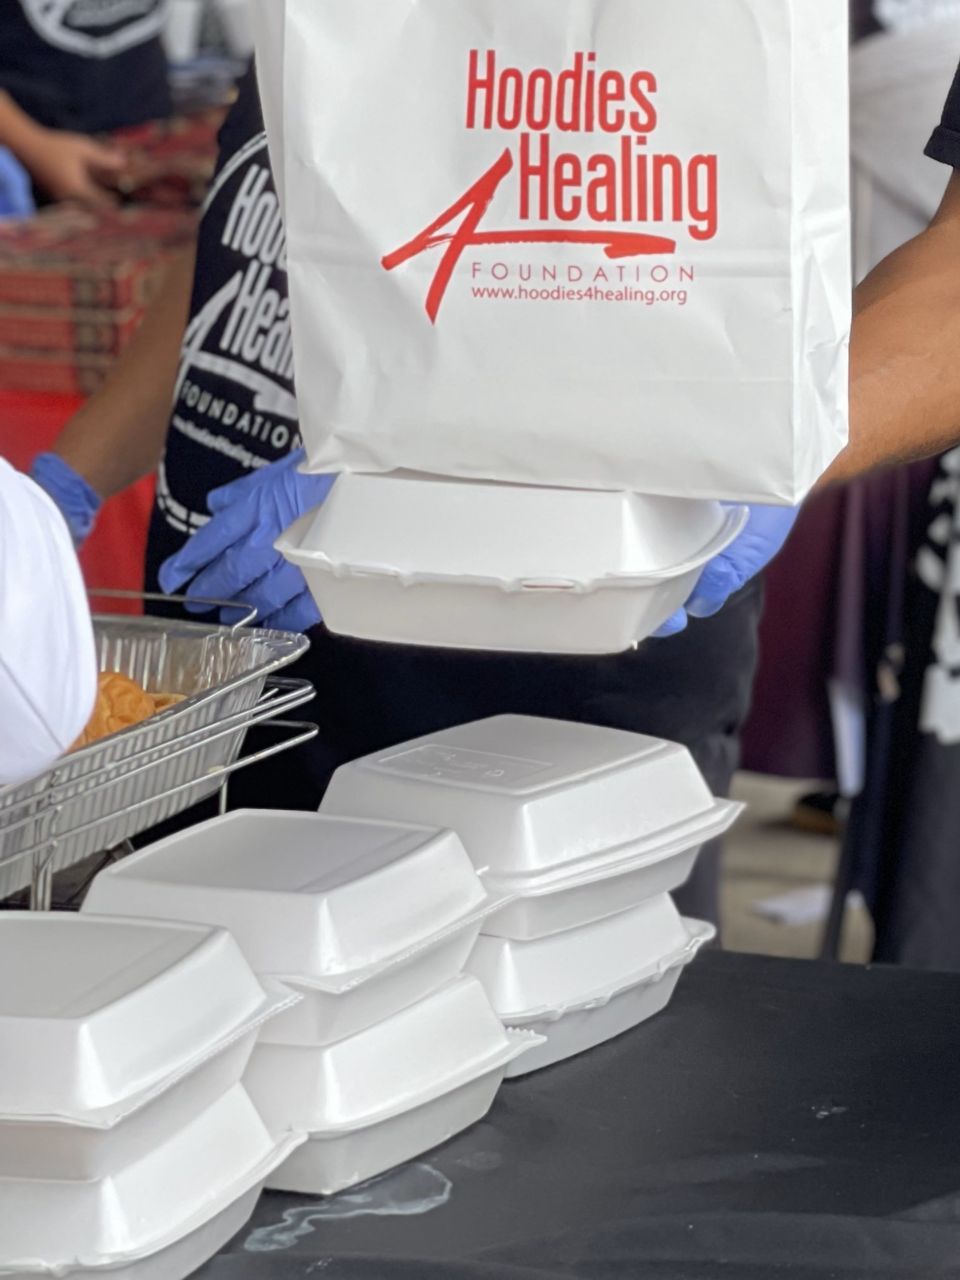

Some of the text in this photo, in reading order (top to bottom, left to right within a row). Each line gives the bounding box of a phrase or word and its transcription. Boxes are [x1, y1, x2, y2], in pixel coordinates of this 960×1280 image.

[464, 48, 658, 134] Hoodies
[379, 132, 719, 326] 4 Healing
[472, 262, 695, 283] FOUNDATION
[472, 285, 688, 305] www.hoodies4healing.org
